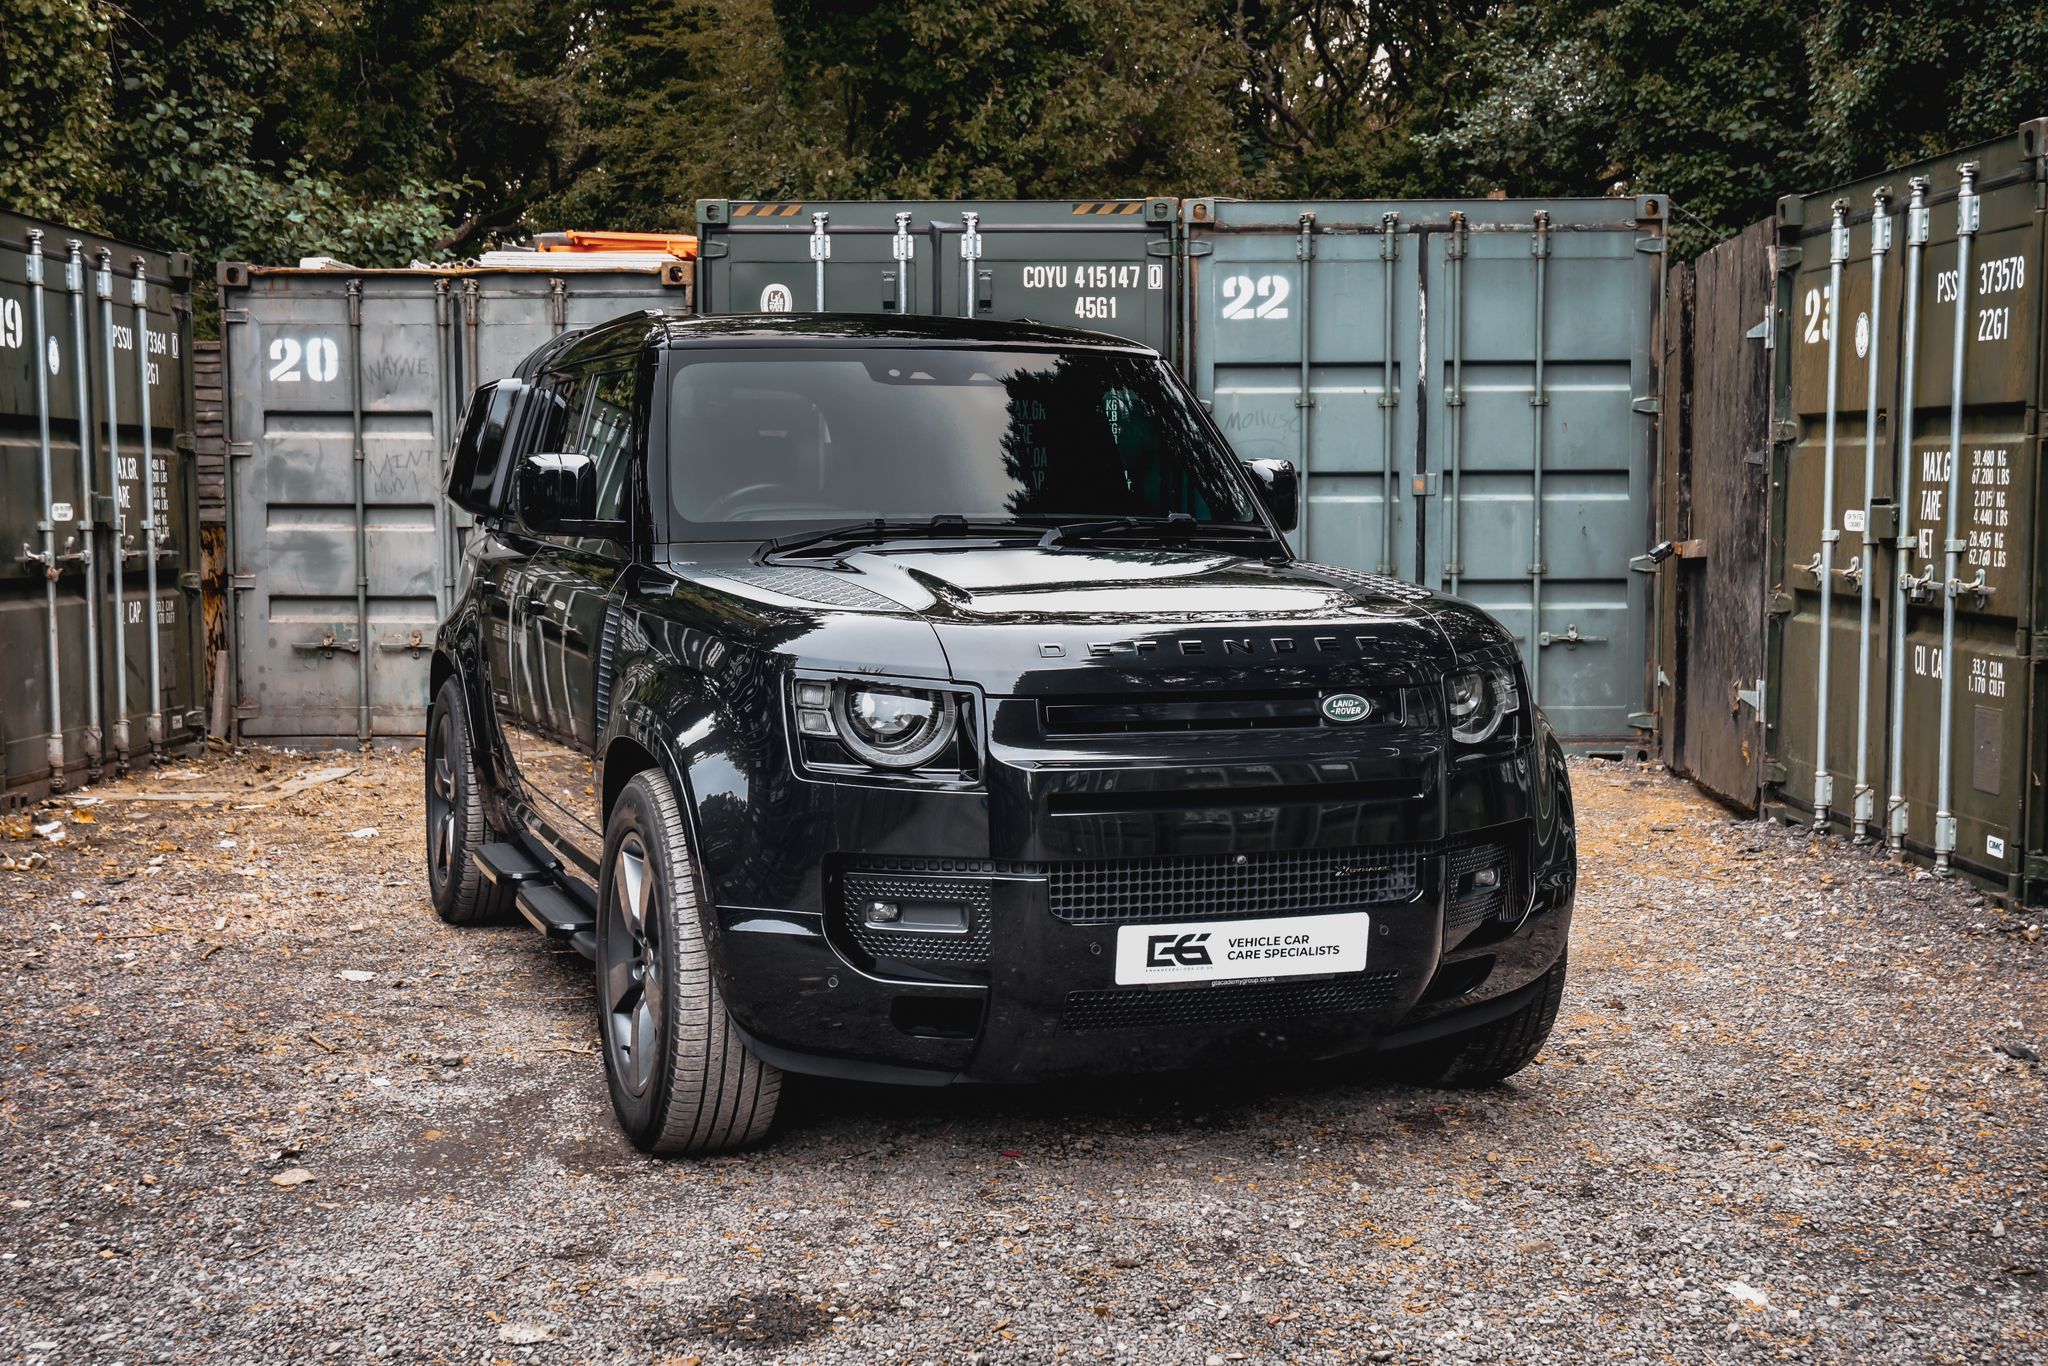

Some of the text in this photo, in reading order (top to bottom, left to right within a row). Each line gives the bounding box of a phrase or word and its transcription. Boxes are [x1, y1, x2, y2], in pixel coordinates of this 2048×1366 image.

[1023, 265, 1067, 288] COYU
[1074, 265, 1140, 288] 415147
[1937, 255, 2025, 304] PSS 373578
[1074, 296, 1116, 319] 45G1
[1222, 274, 1291, 321] 22
[1978, 306, 2009, 341] 22G1
[112, 324, 133, 351] PSSU
[145, 329, 167, 356] 73364
[269, 337, 340, 383] 20
[146, 362, 160, 386] 2G1
[117, 457, 139, 480] AX.GR.
[1922, 450, 2007, 482] MAX.G 30.480 KG
[1971, 468, 2010, 486] 67.200 LBS
[118, 485, 131, 509] ARE
[1920, 490, 2006, 521] TARE 2.015 KG
[1973, 508, 2009, 527] 4.440 LBS
[1919, 528, 2004, 559] NET 28.465 KG
[1968, 549, 2007, 568] 62.760 LBS
[1037, 635, 1384, 659] DEFENDER
[1914, 645, 1927, 677] CU.
[1931, 648, 1943, 680] CA
[1972, 658, 1987, 676] 33.2
[1968, 675, 1986, 694] 1.170
[1332, 699, 1354, 709] LAND
[1335, 706, 1361, 716] ROVER
[1227, 945, 1340, 961] CARE SPECIALISTS
[1228, 934, 1310, 948] VEHICLE CAR
